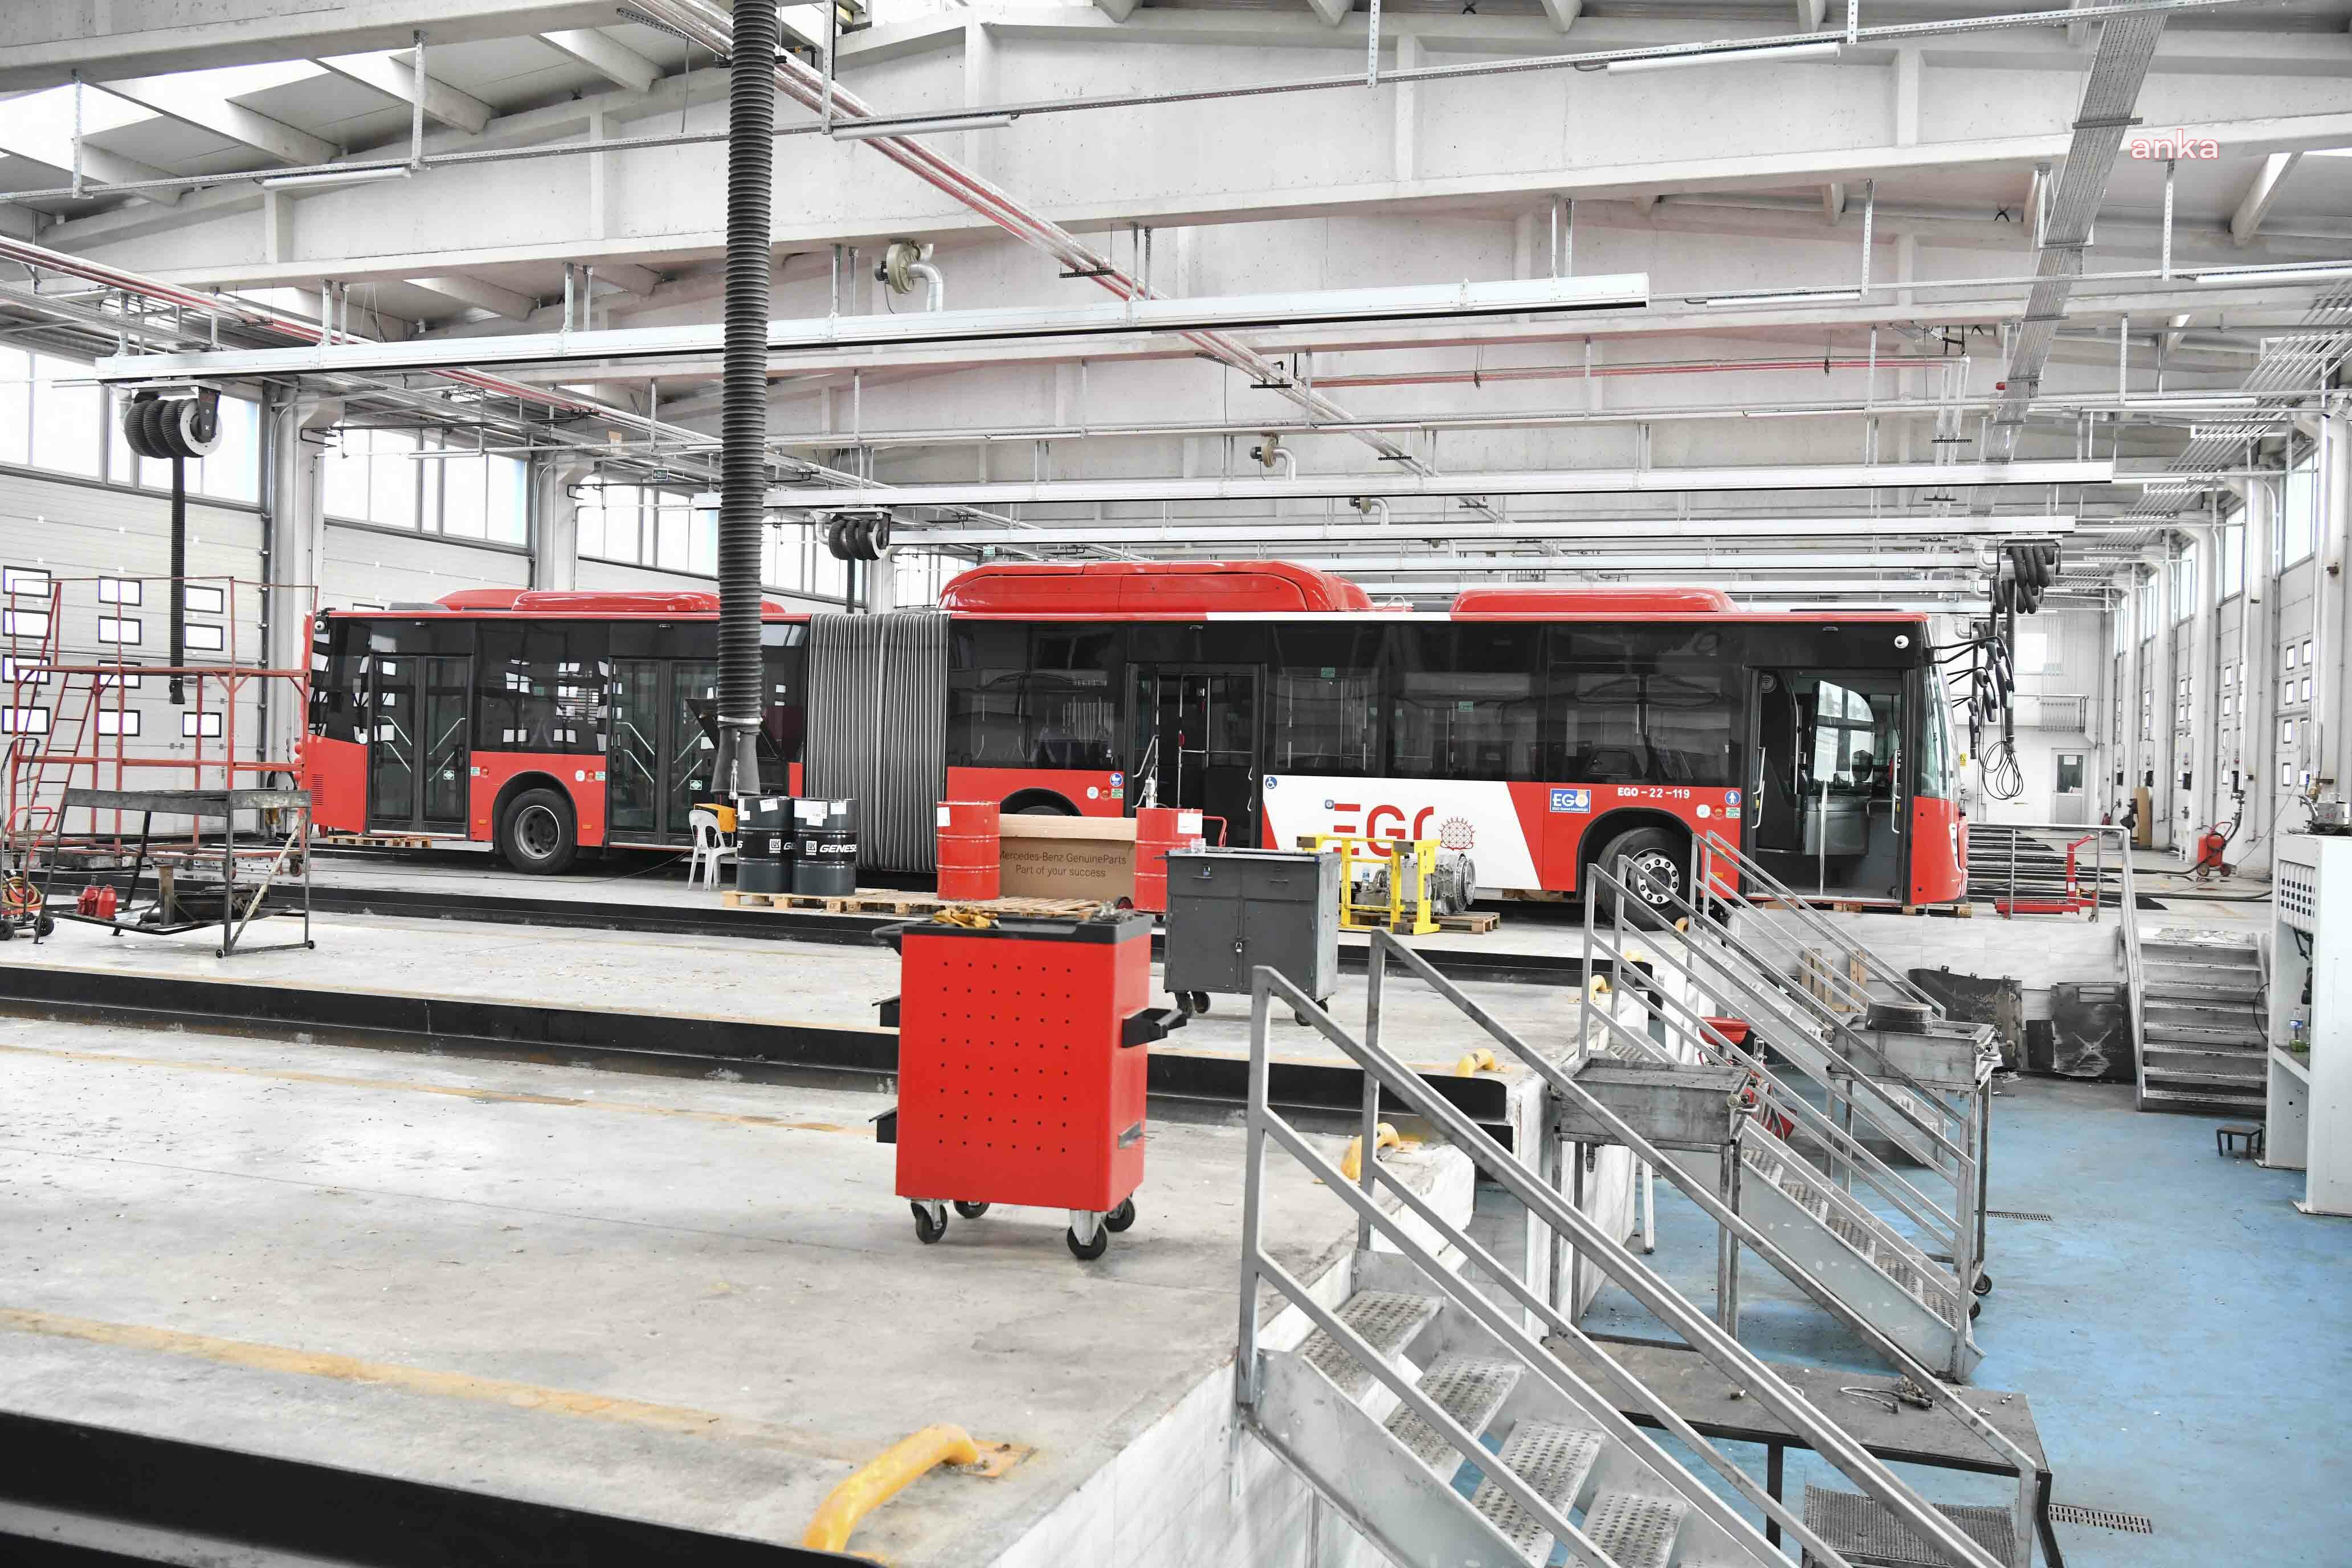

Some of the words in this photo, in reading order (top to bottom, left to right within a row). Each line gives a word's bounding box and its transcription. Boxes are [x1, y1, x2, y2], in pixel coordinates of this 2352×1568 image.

[1618, 787, 1639, 797] EGO
[1553, 793, 1589, 807] EGO
[1016, 864, 1034, 874] Part
[1036, 865, 1045, 875] of
[1047, 868, 1067, 877] your
[1070, 868, 1106, 877] success
